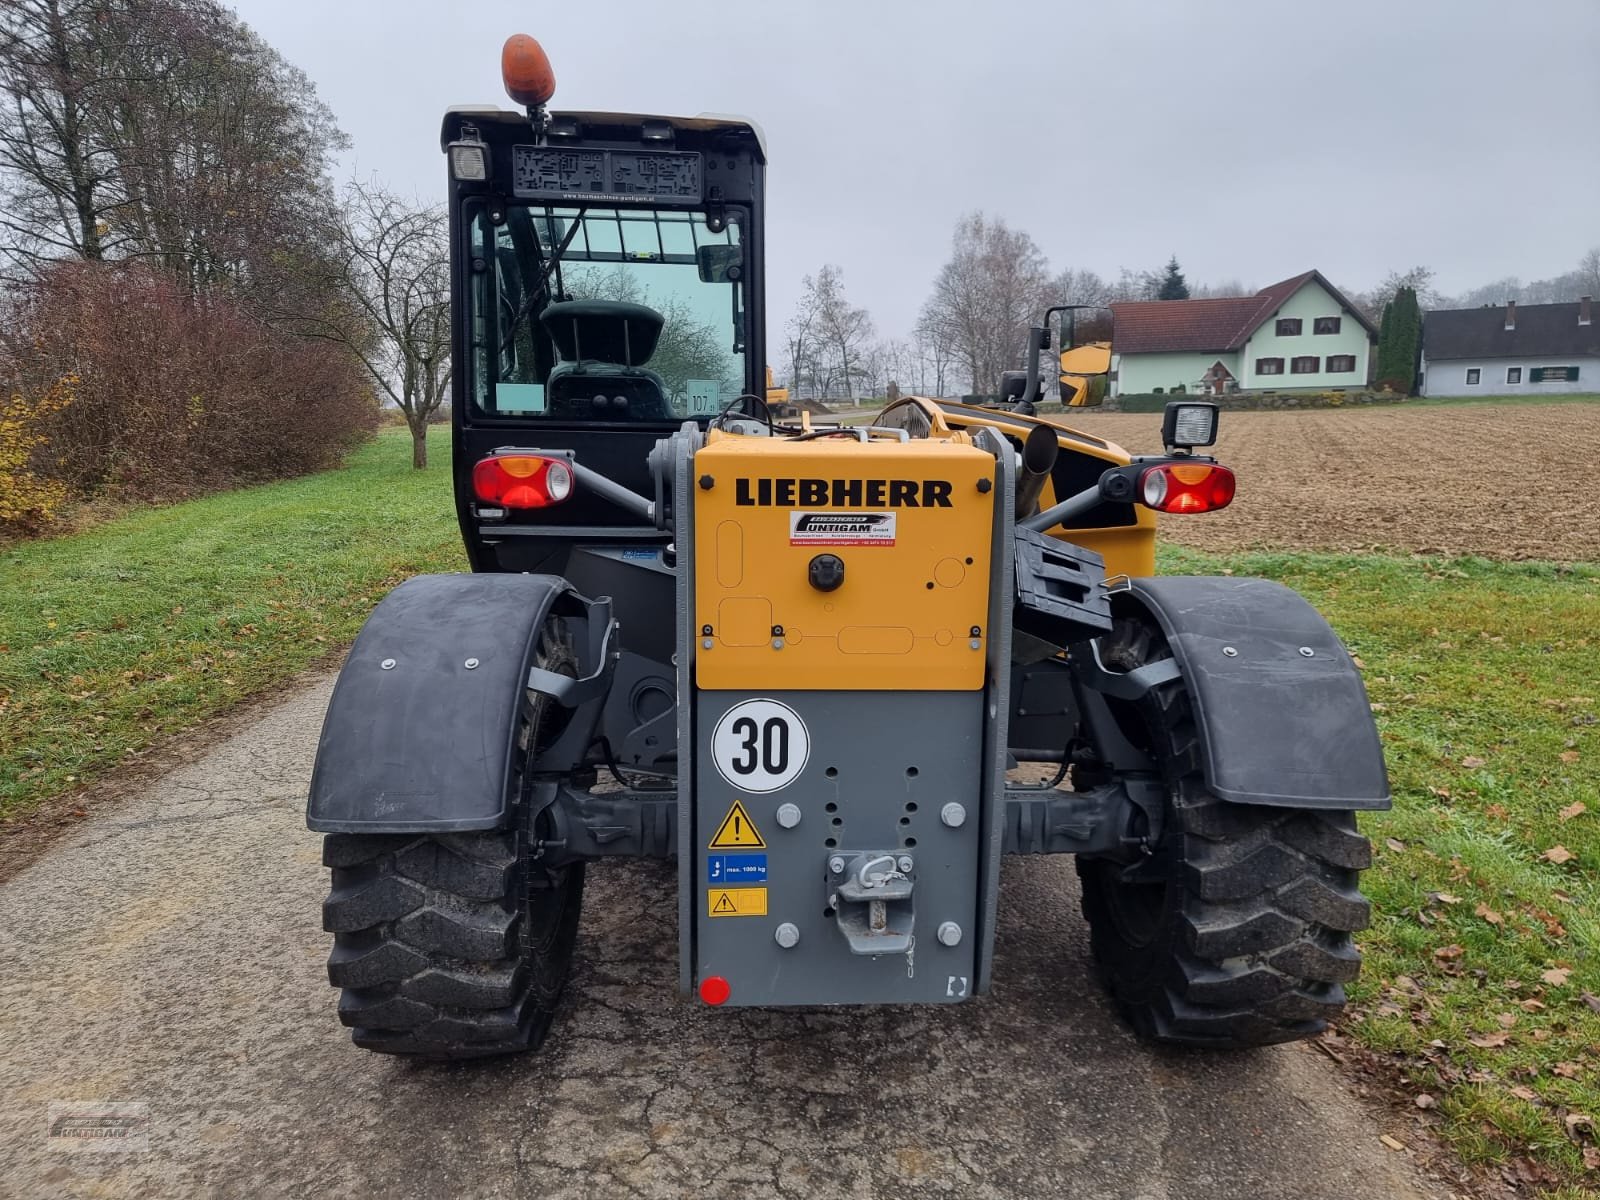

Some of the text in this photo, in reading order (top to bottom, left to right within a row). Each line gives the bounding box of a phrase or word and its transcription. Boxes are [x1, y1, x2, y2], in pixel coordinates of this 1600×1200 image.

[692, 395, 708, 411] 107
[735, 478, 953, 508] LIEBHERR
[732, 716, 789, 775] 30
